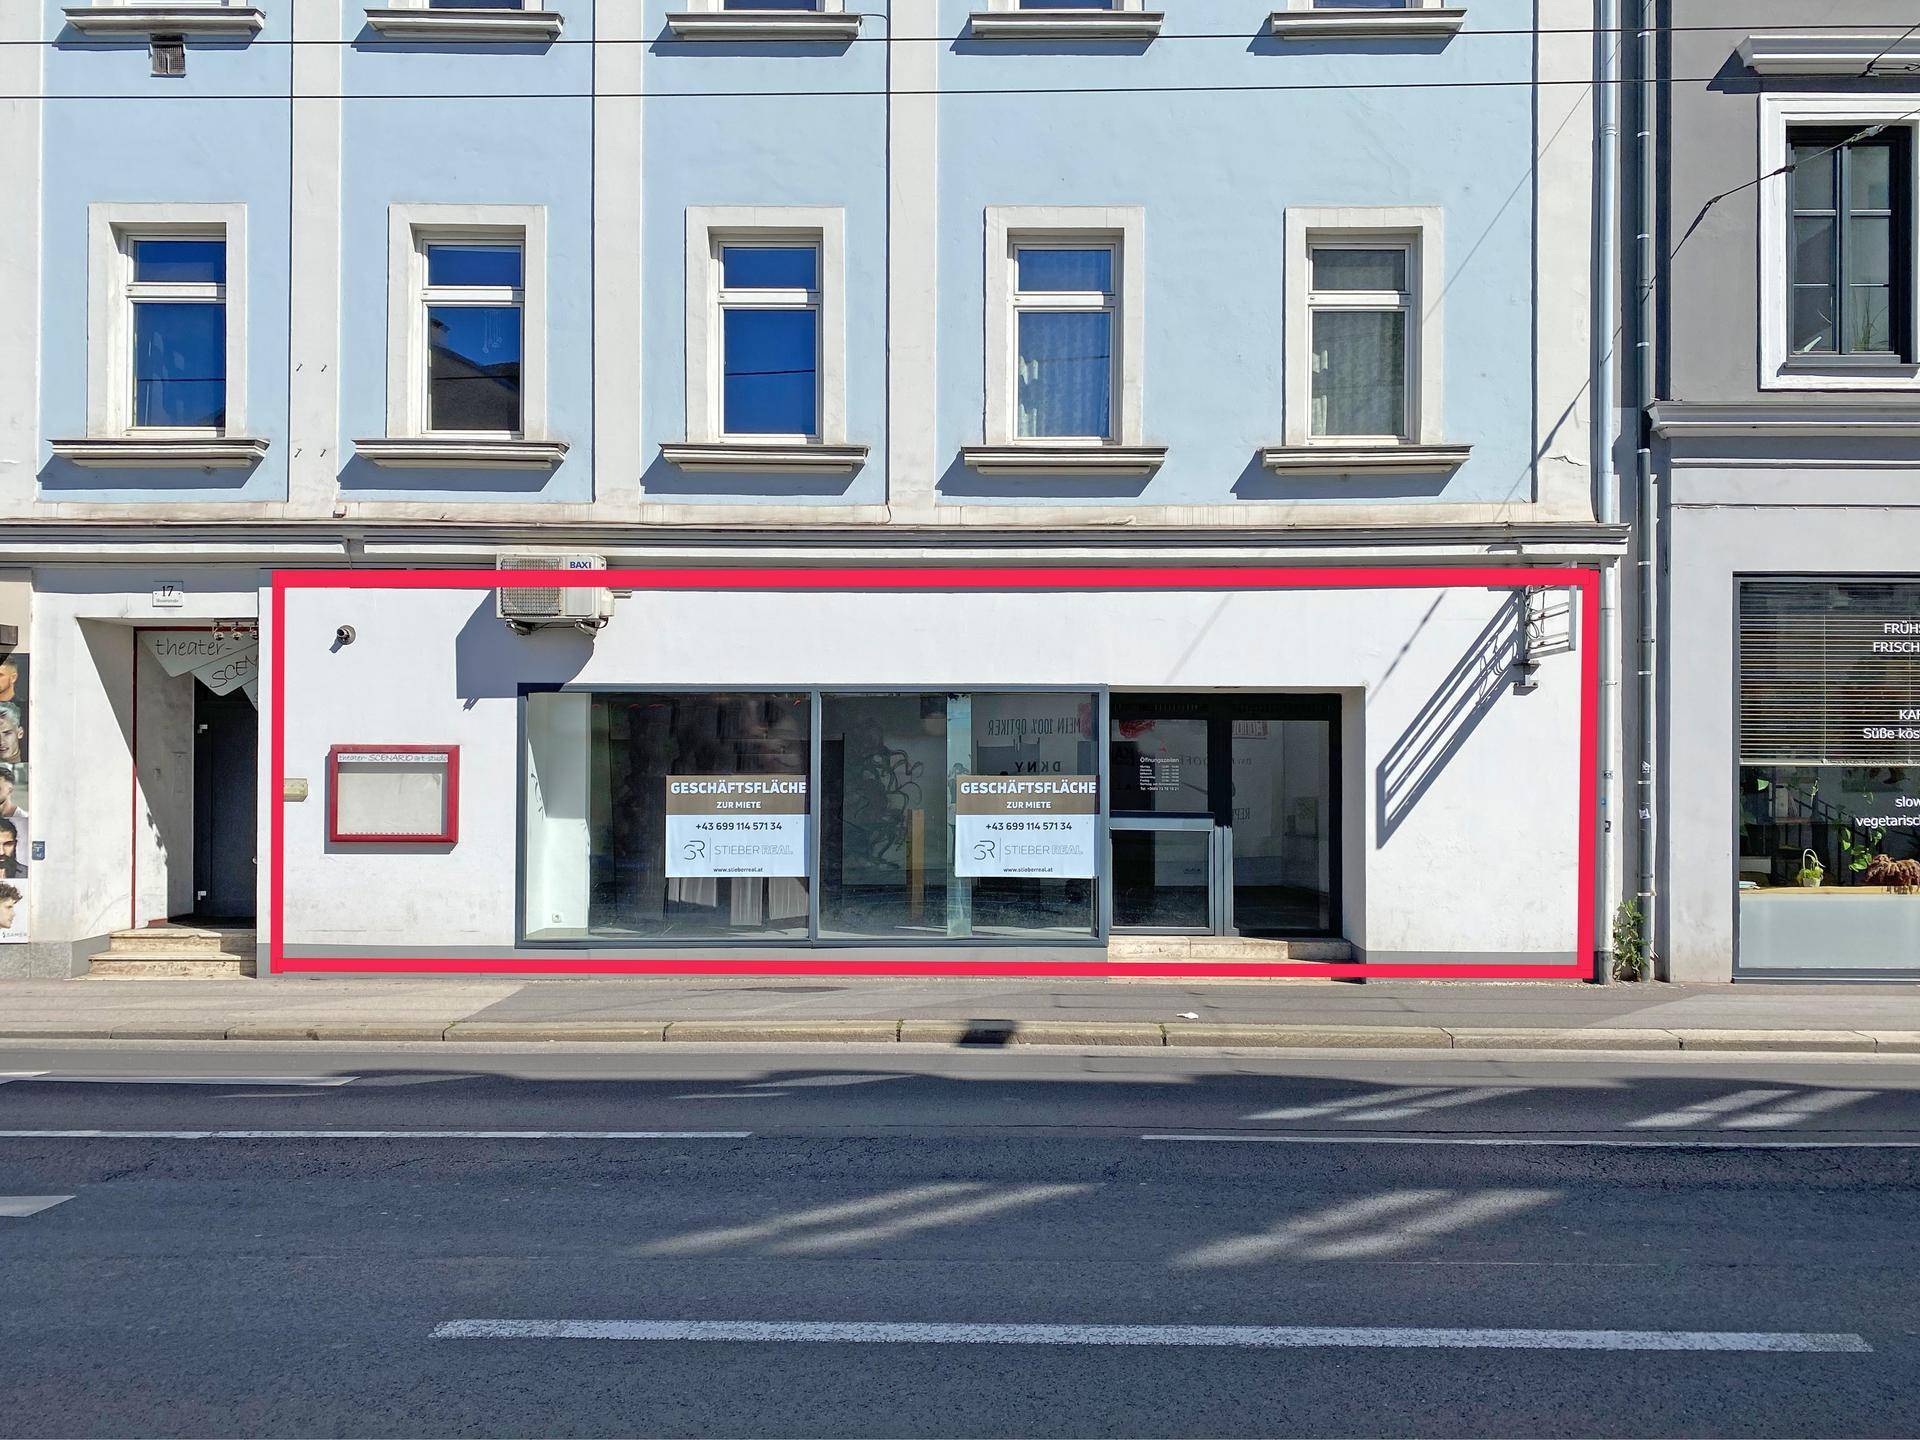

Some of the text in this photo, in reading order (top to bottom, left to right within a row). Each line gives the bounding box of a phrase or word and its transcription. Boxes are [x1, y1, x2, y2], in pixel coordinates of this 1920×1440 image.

[162, 586, 174, 596] 17
[1863, 727, 1895, 739] Süße
[670, 780, 806, 794] GESCHÄFTSFLÄCHE
[960, 780, 1096, 794] GESCHÄFTSFLÄCHE
[696, 822, 782, 830] +43 699 114 571 34
[986, 822, 1072, 830] +43 699 114 571 34
